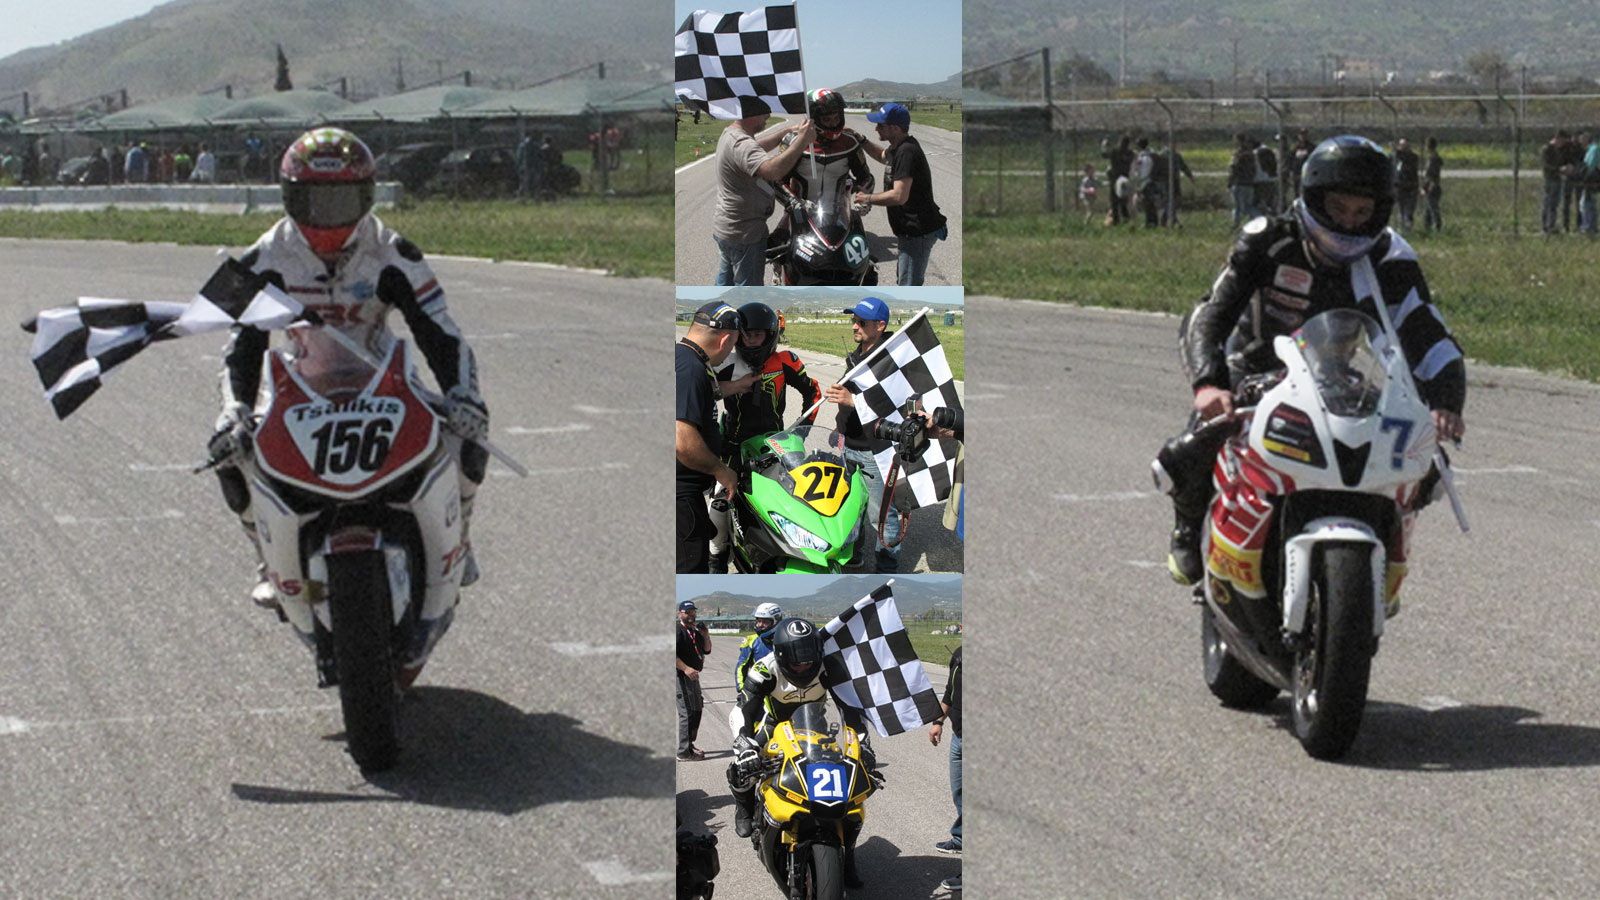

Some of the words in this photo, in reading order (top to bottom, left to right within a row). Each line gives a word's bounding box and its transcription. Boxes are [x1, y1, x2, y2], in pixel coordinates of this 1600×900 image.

[844, 236, 870, 265] 42
[311, 417, 394, 475] 156
[1381, 417, 1414, 470] 7
[802, 466, 842, 501] 27
[887, 468, 897, 488] Canon
[812, 768, 844, 798] 21
